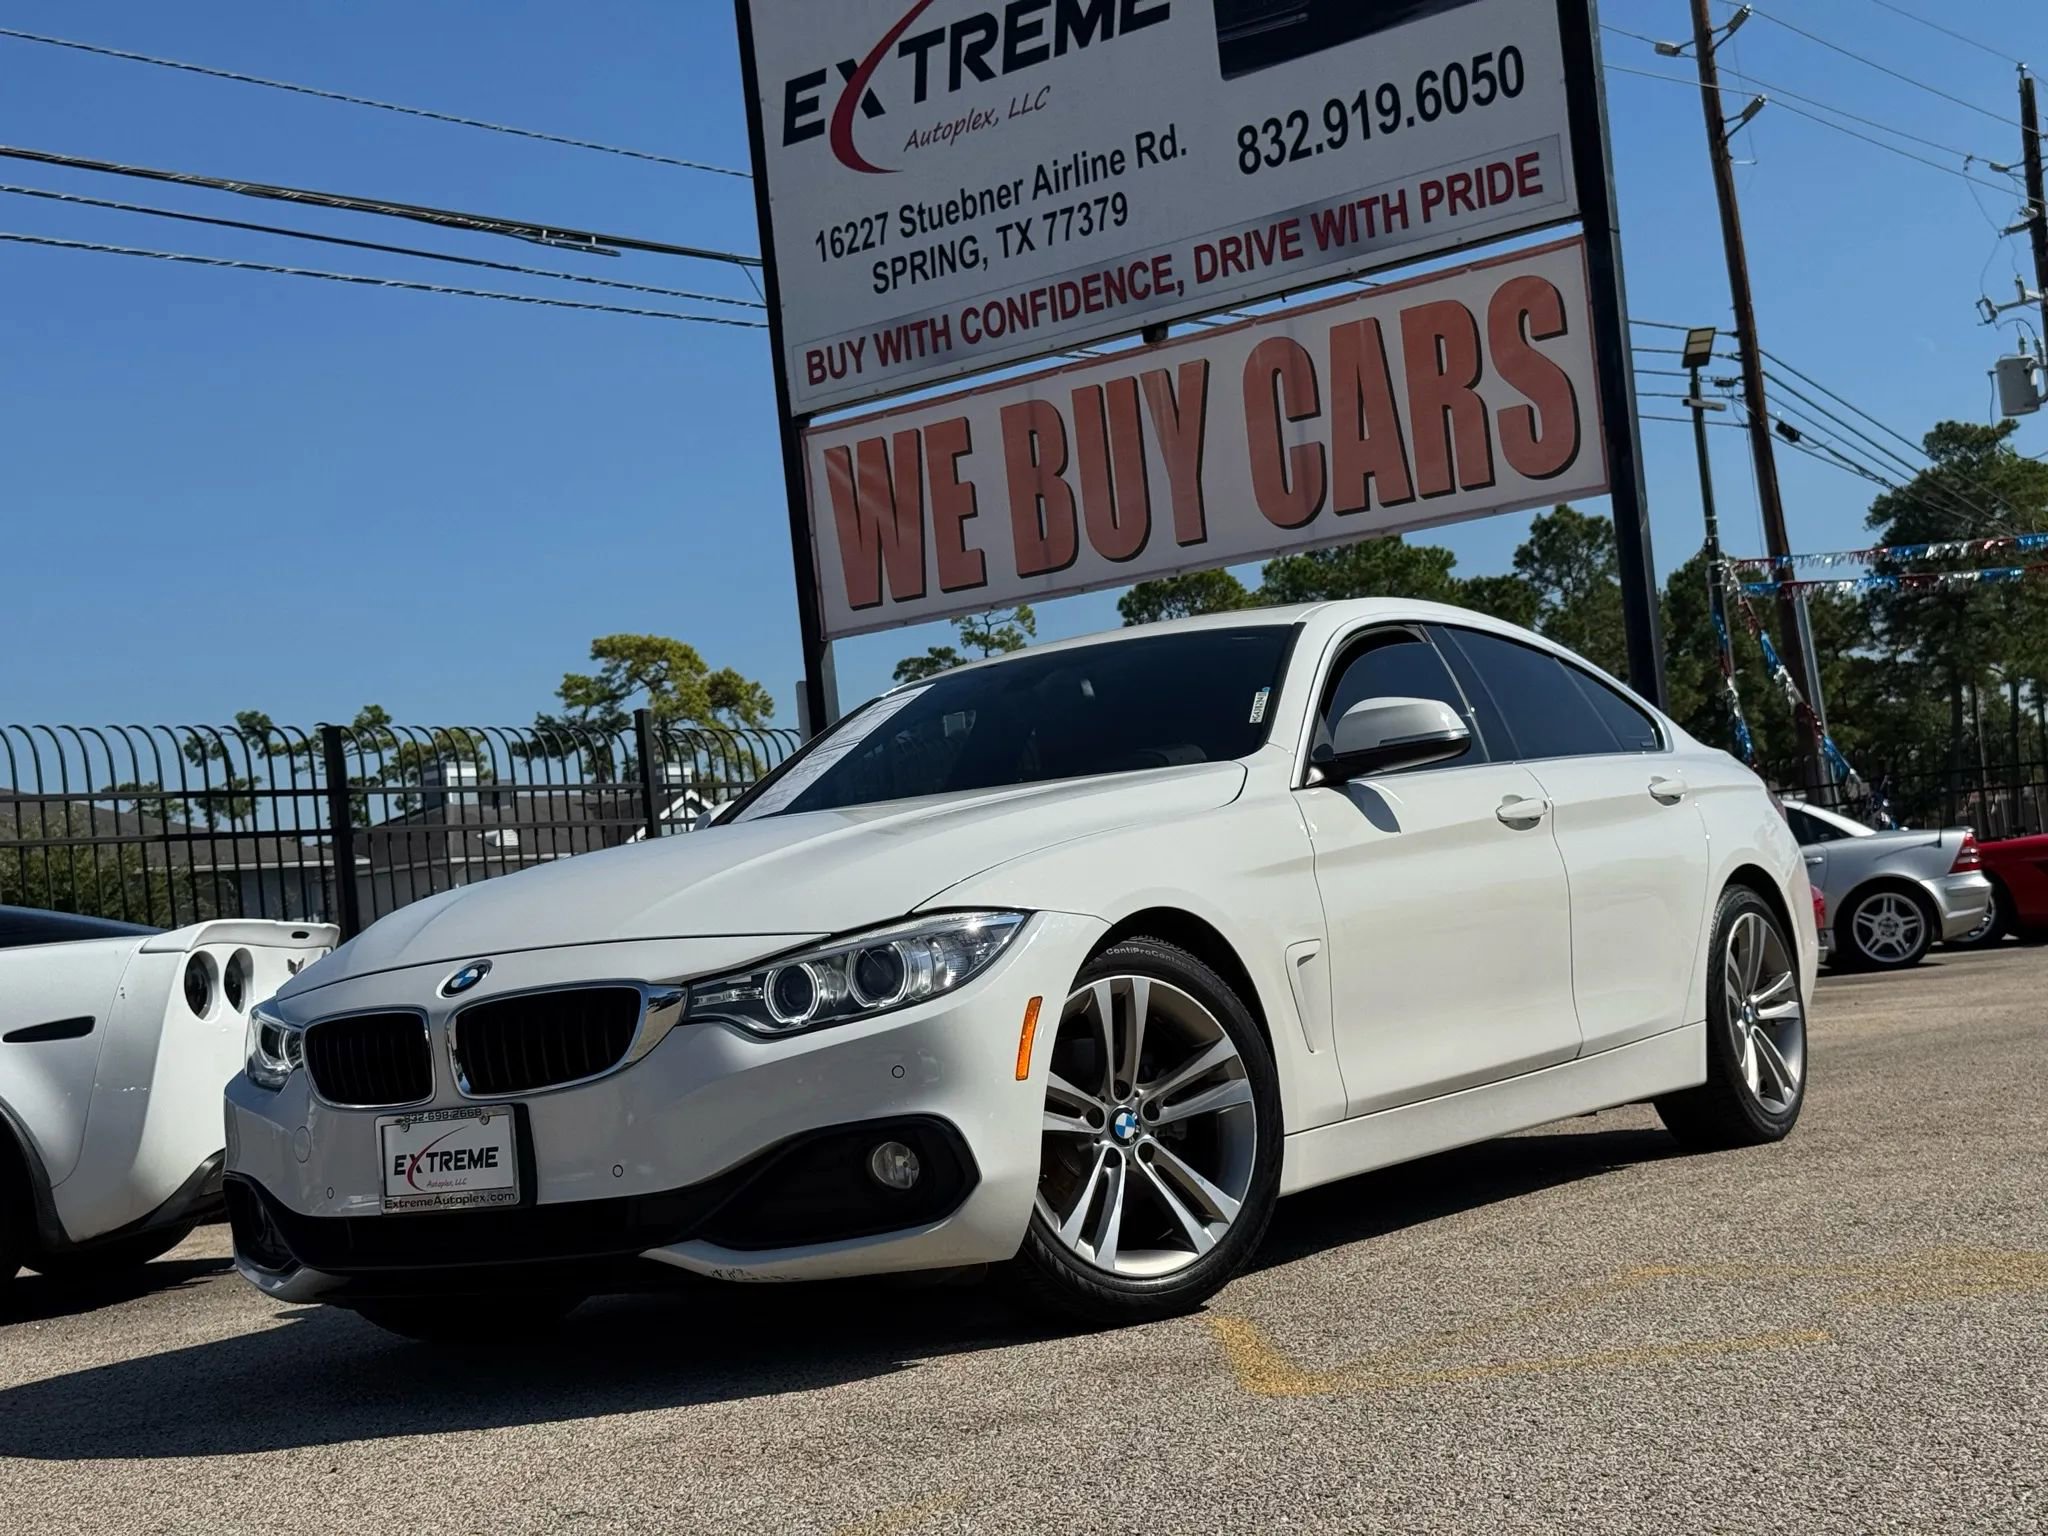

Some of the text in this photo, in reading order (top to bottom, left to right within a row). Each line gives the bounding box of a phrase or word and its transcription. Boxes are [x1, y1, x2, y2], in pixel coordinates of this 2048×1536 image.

[903, 86, 1051, 152] Autoplex, LLC
[1238, 45, 1524, 175] 832.919.6050
[815, 124, 1187, 262] 16227 Stuebner Airline Rd.
[872, 192, 1128, 294] SPRING, TX 77379
[806, 152, 1543, 385] BUY WITH CONFIDENCE, DRIVE WITH PRIDE
[824, 275, 1581, 610] WE BUY CARS
[385, 1192, 515, 1209] ExtremeAutoplex.com
[394, 1147, 498, 1175] EXTREME
